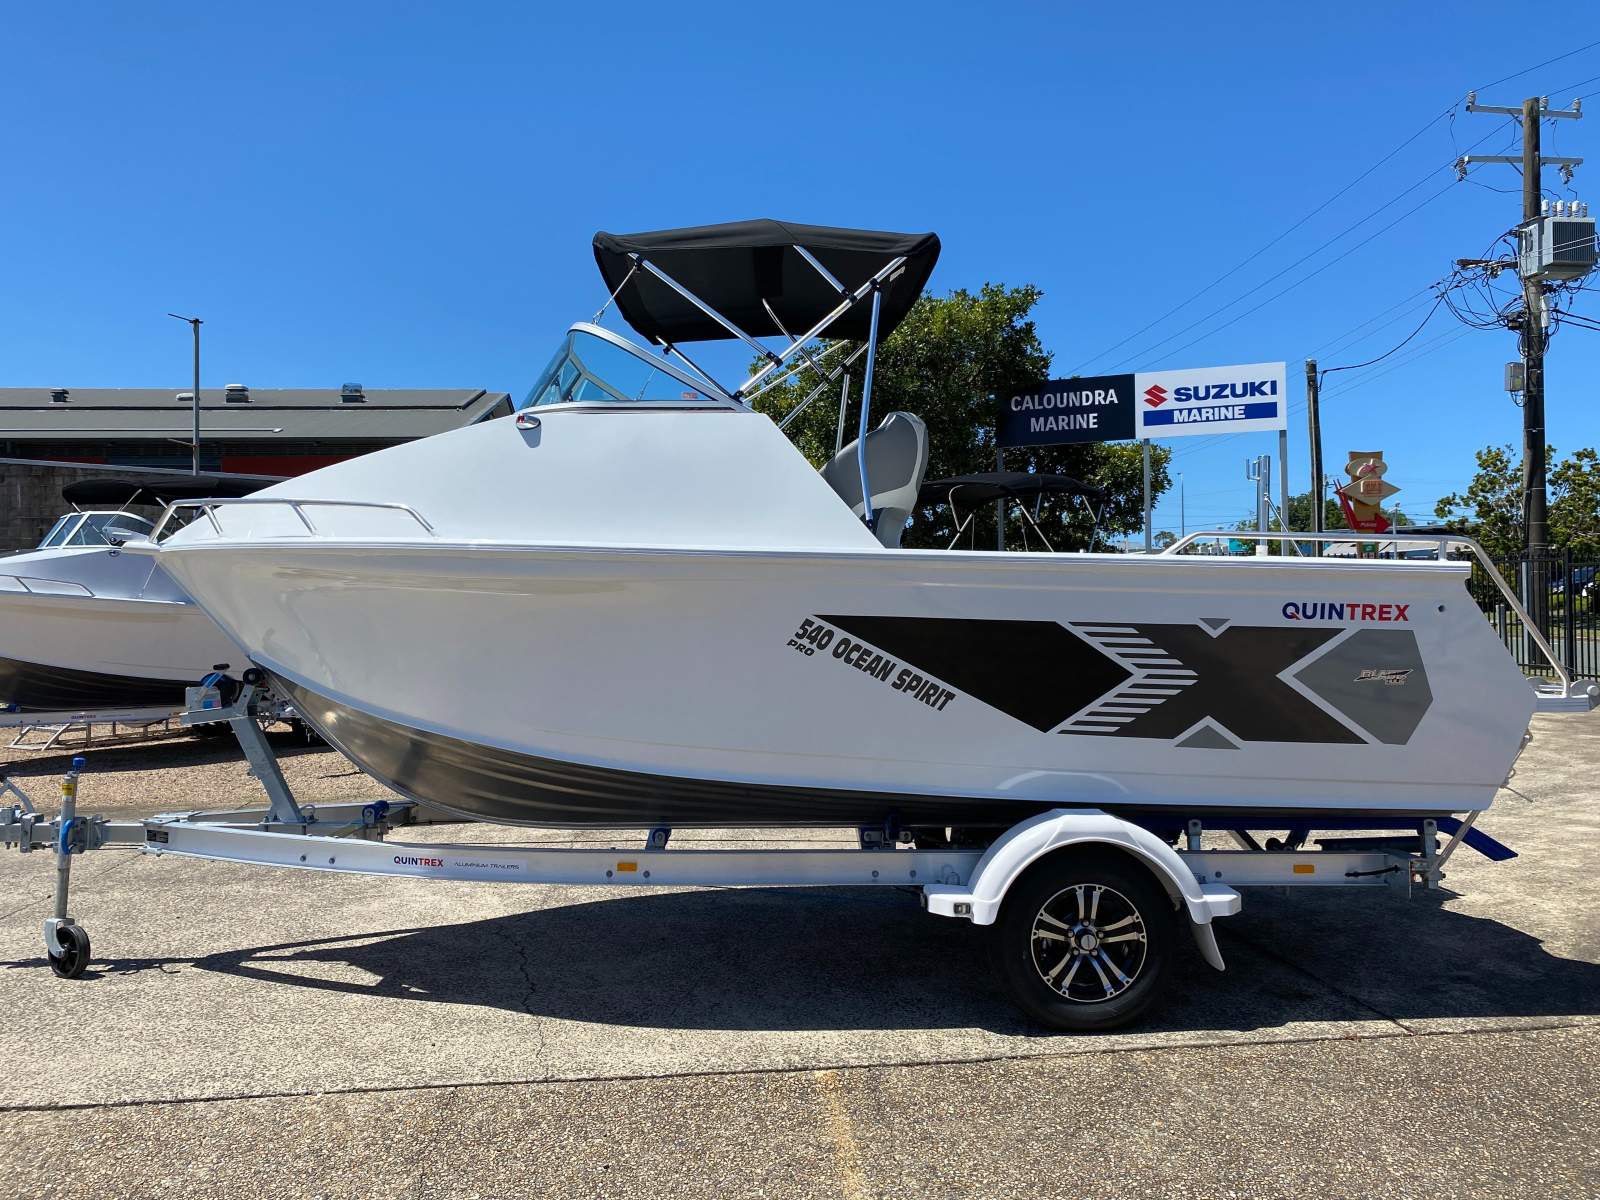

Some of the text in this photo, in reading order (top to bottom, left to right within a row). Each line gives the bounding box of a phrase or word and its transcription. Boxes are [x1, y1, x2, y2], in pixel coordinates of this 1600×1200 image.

[1010, 388, 1119, 412] CALOUNDRA
[1173, 379, 1278, 402] SUZUKI
[1029, 412, 1099, 433] MARINE
[1172, 405, 1246, 424] MARINE
[1282, 601, 1410, 622] QUINTREX
[786, 638, 816, 657] PRO
[794, 617, 957, 712] 540 OCEAN SPIRIT
[393, 855, 444, 868] QUINTREX
